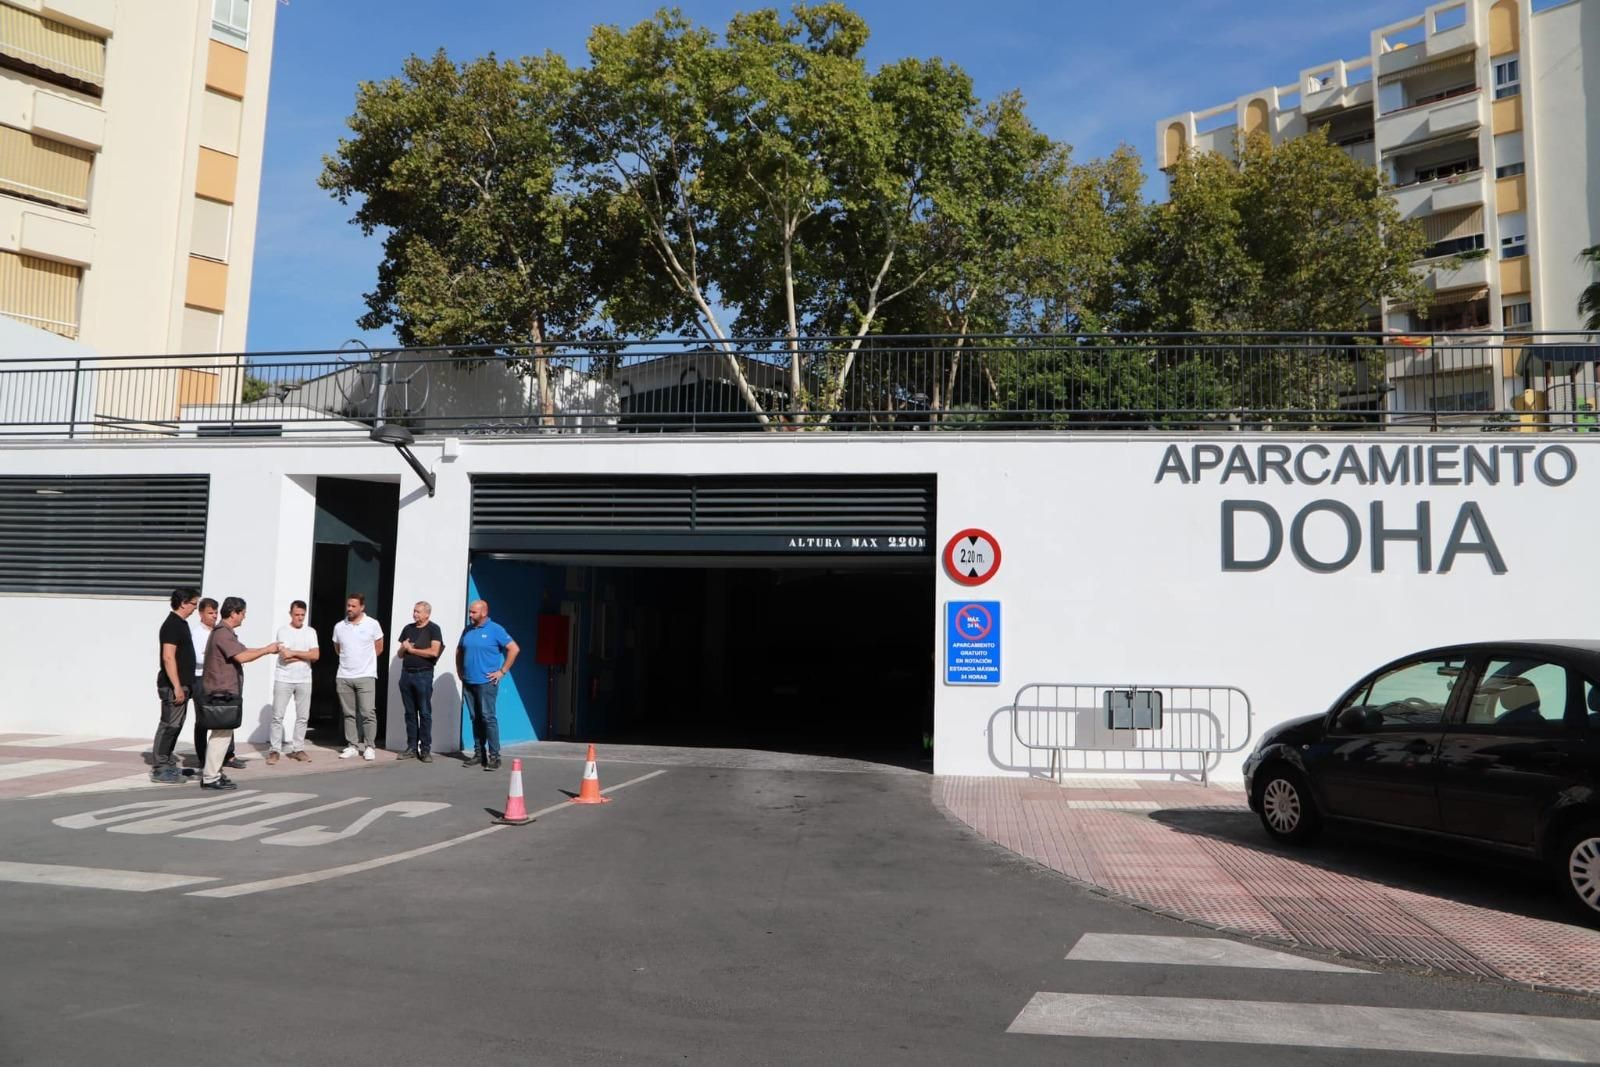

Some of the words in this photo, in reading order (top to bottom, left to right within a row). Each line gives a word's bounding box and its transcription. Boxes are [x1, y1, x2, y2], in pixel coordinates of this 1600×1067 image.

[1154, 444, 1578, 487] APARCAMIENTO
[788, 537, 842, 548] ALTURA
[851, 537, 878, 548] MAX
[1221, 498, 1508, 575] DOHA
[52, 790, 452, 847] STOP
